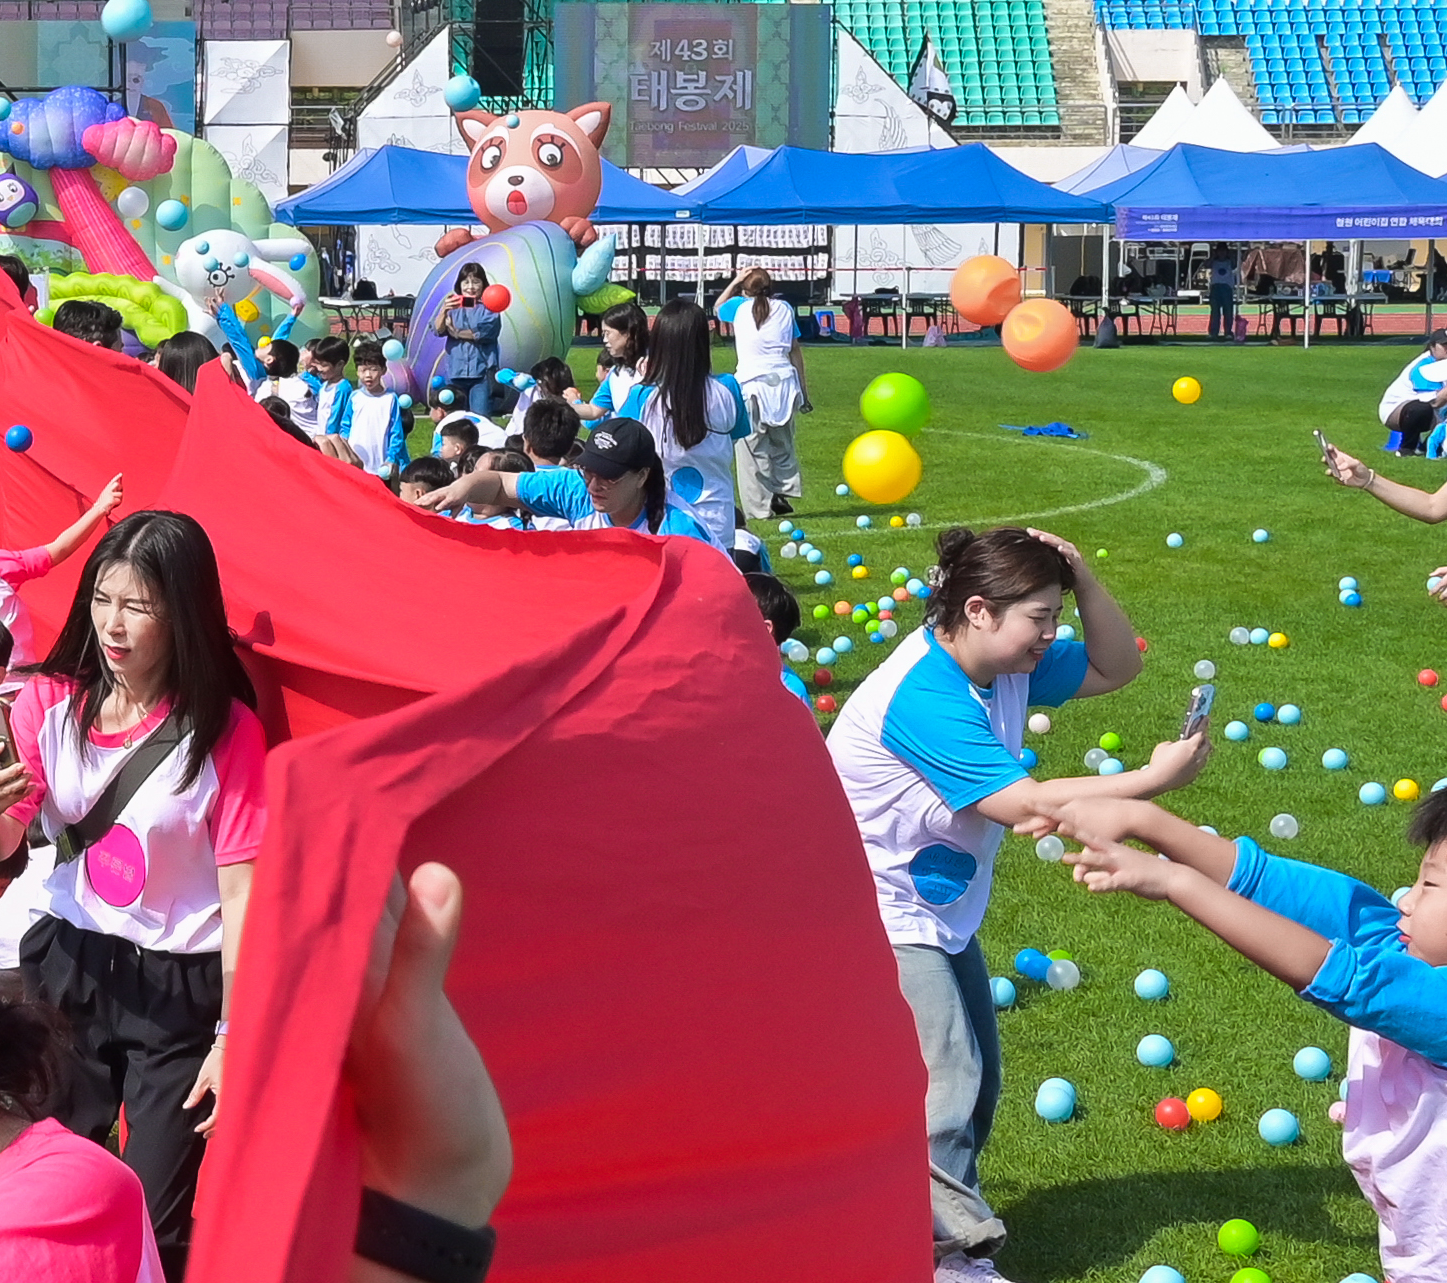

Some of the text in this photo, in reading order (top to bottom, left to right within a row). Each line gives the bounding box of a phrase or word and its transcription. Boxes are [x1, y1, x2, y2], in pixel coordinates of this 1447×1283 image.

[650, 38, 734, 62] 제43회
[628, 69, 753, 112] 태봉제
[629, 121, 674, 133] Taebong
[722, 121, 750, 131] 2025
[1354, 217, 1389, 227] 어린이집
